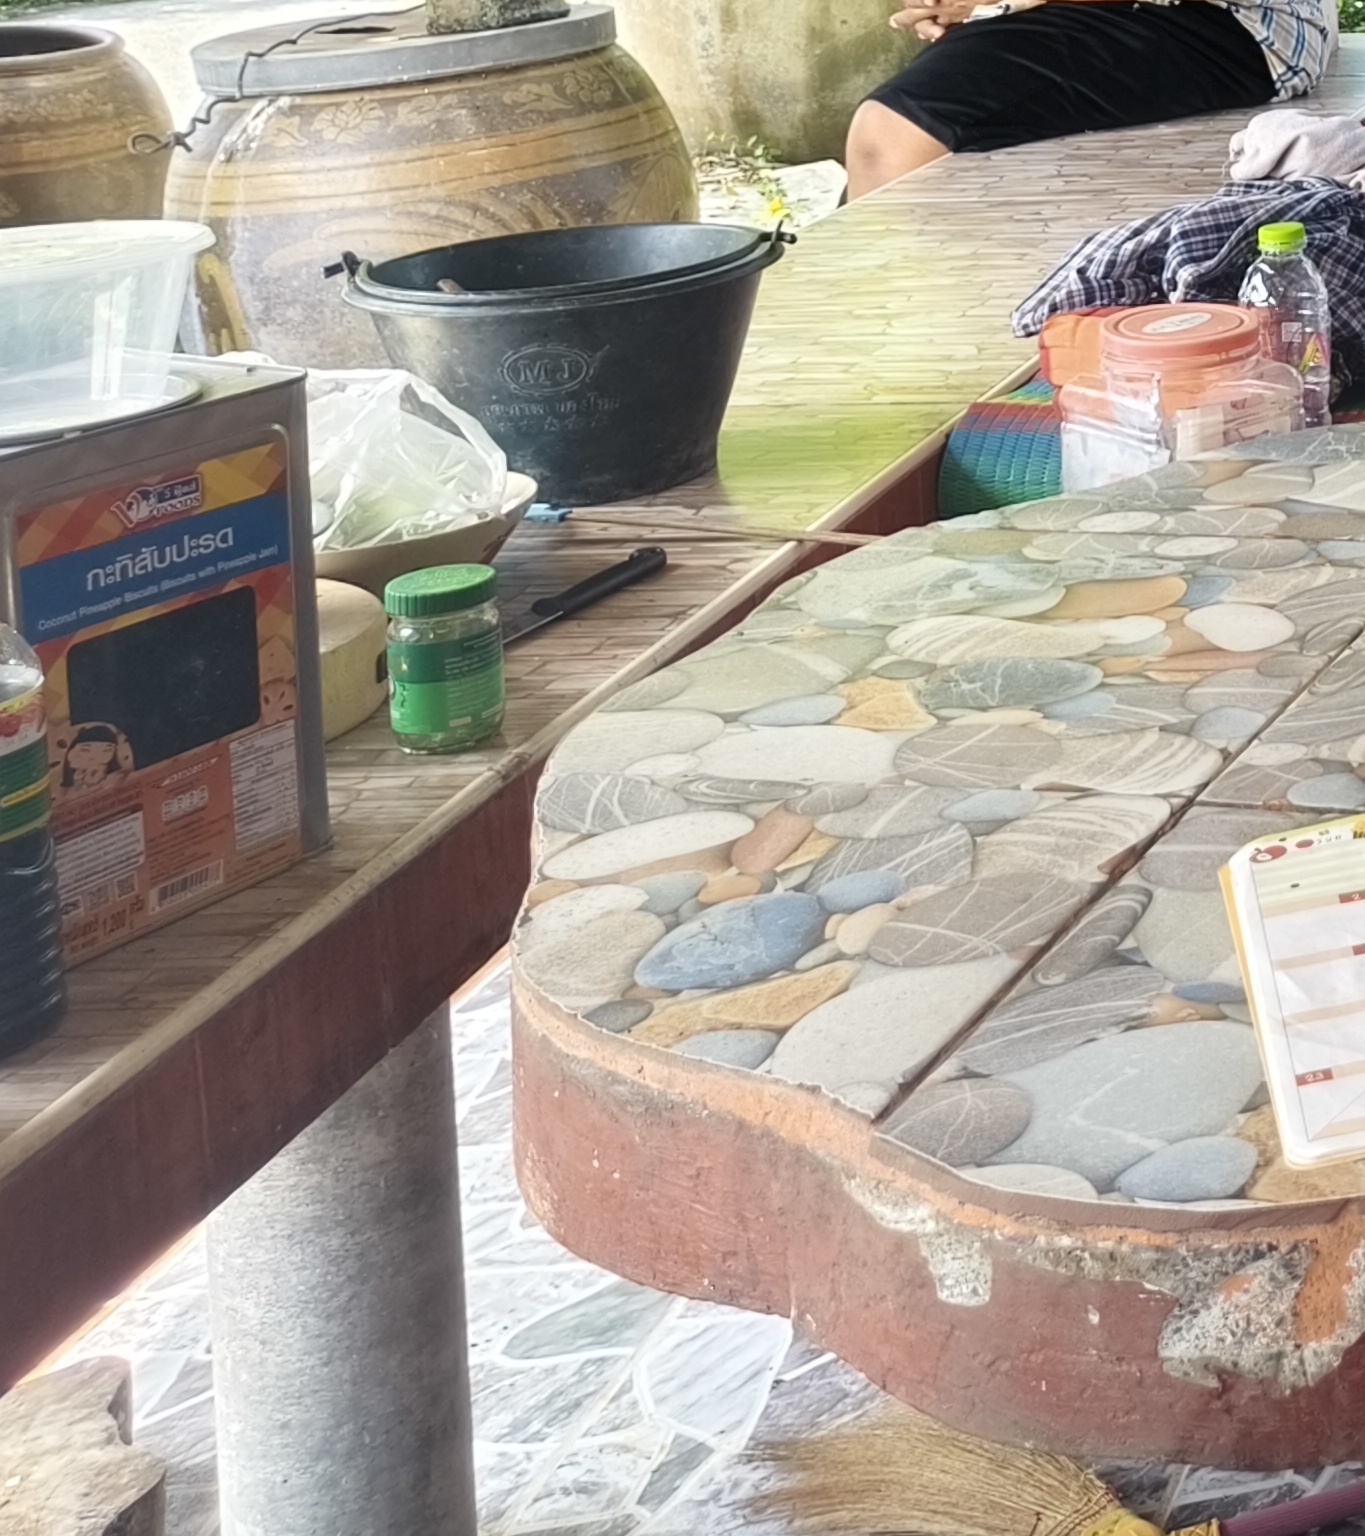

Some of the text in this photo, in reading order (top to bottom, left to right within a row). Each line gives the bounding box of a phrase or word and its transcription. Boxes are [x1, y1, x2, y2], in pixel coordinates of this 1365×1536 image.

[155, 495, 201, 517] FOODS
[86, 526, 235, 591] กะทิสับปะรด
[38, 543, 279, 631] Coconut Pineapple Biscuits (Biscuits with Pineapple Jam)
[1304, 1070, 1326, 1083] 23
